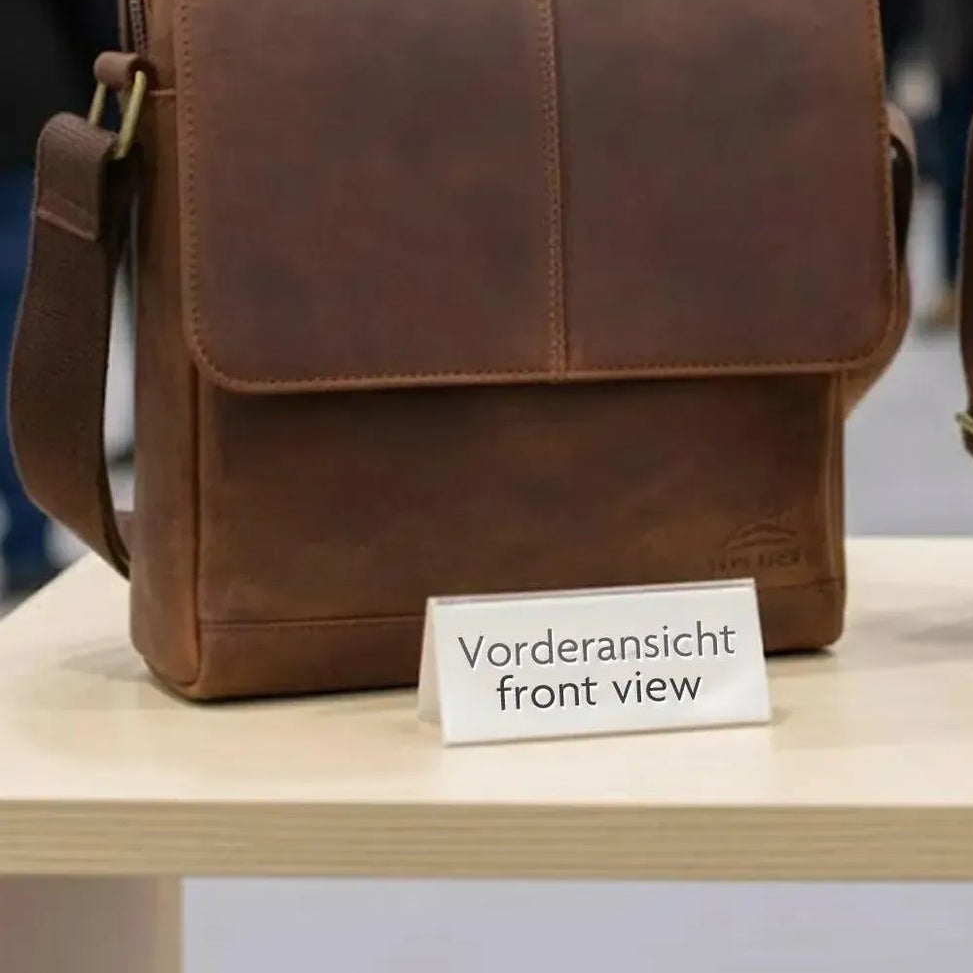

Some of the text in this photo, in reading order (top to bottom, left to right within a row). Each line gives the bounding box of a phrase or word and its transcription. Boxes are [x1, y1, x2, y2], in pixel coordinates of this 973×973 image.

[457, 620, 737, 669] Vorderansicht
[496, 670, 702, 711] front view
